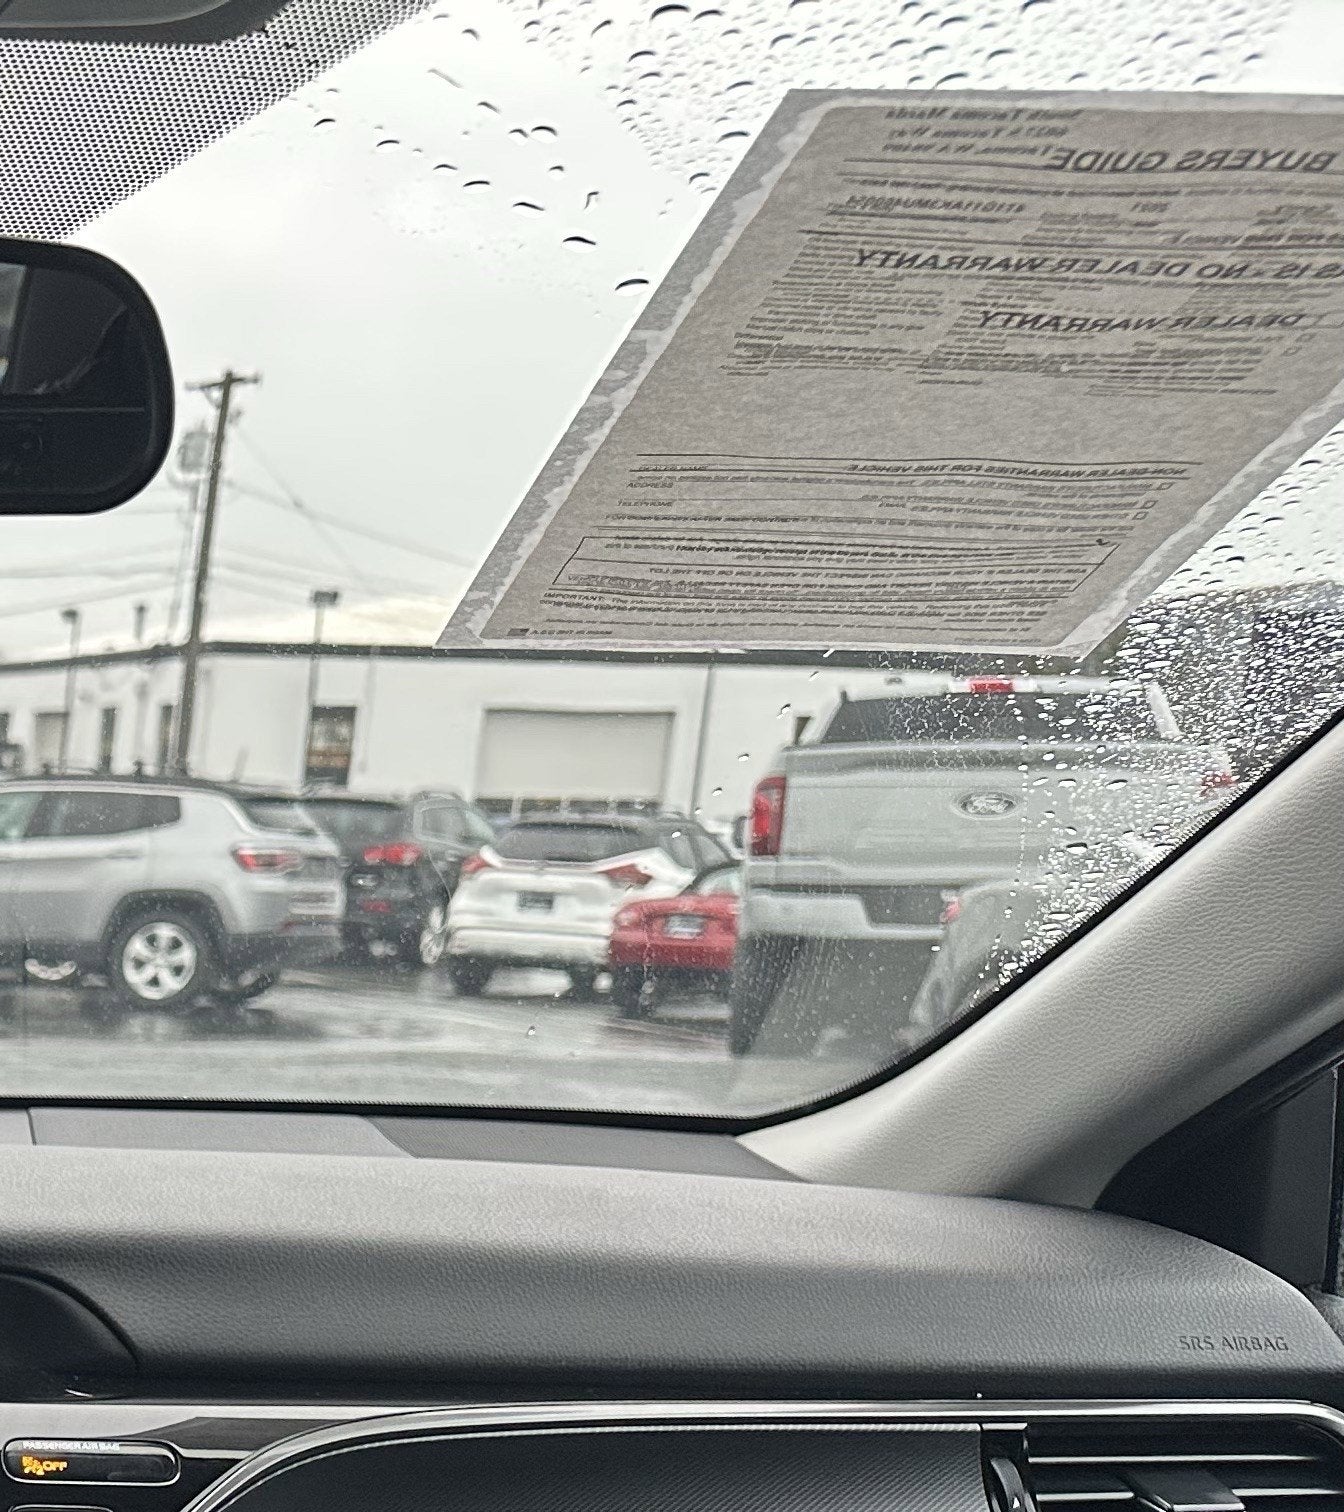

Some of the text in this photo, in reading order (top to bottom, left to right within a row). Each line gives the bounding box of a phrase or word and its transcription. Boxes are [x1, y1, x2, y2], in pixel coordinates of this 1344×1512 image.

[1178, 1335, 1289, 1352] SRS AIRBAG
[42, 1460, 68, 1472] OFF
